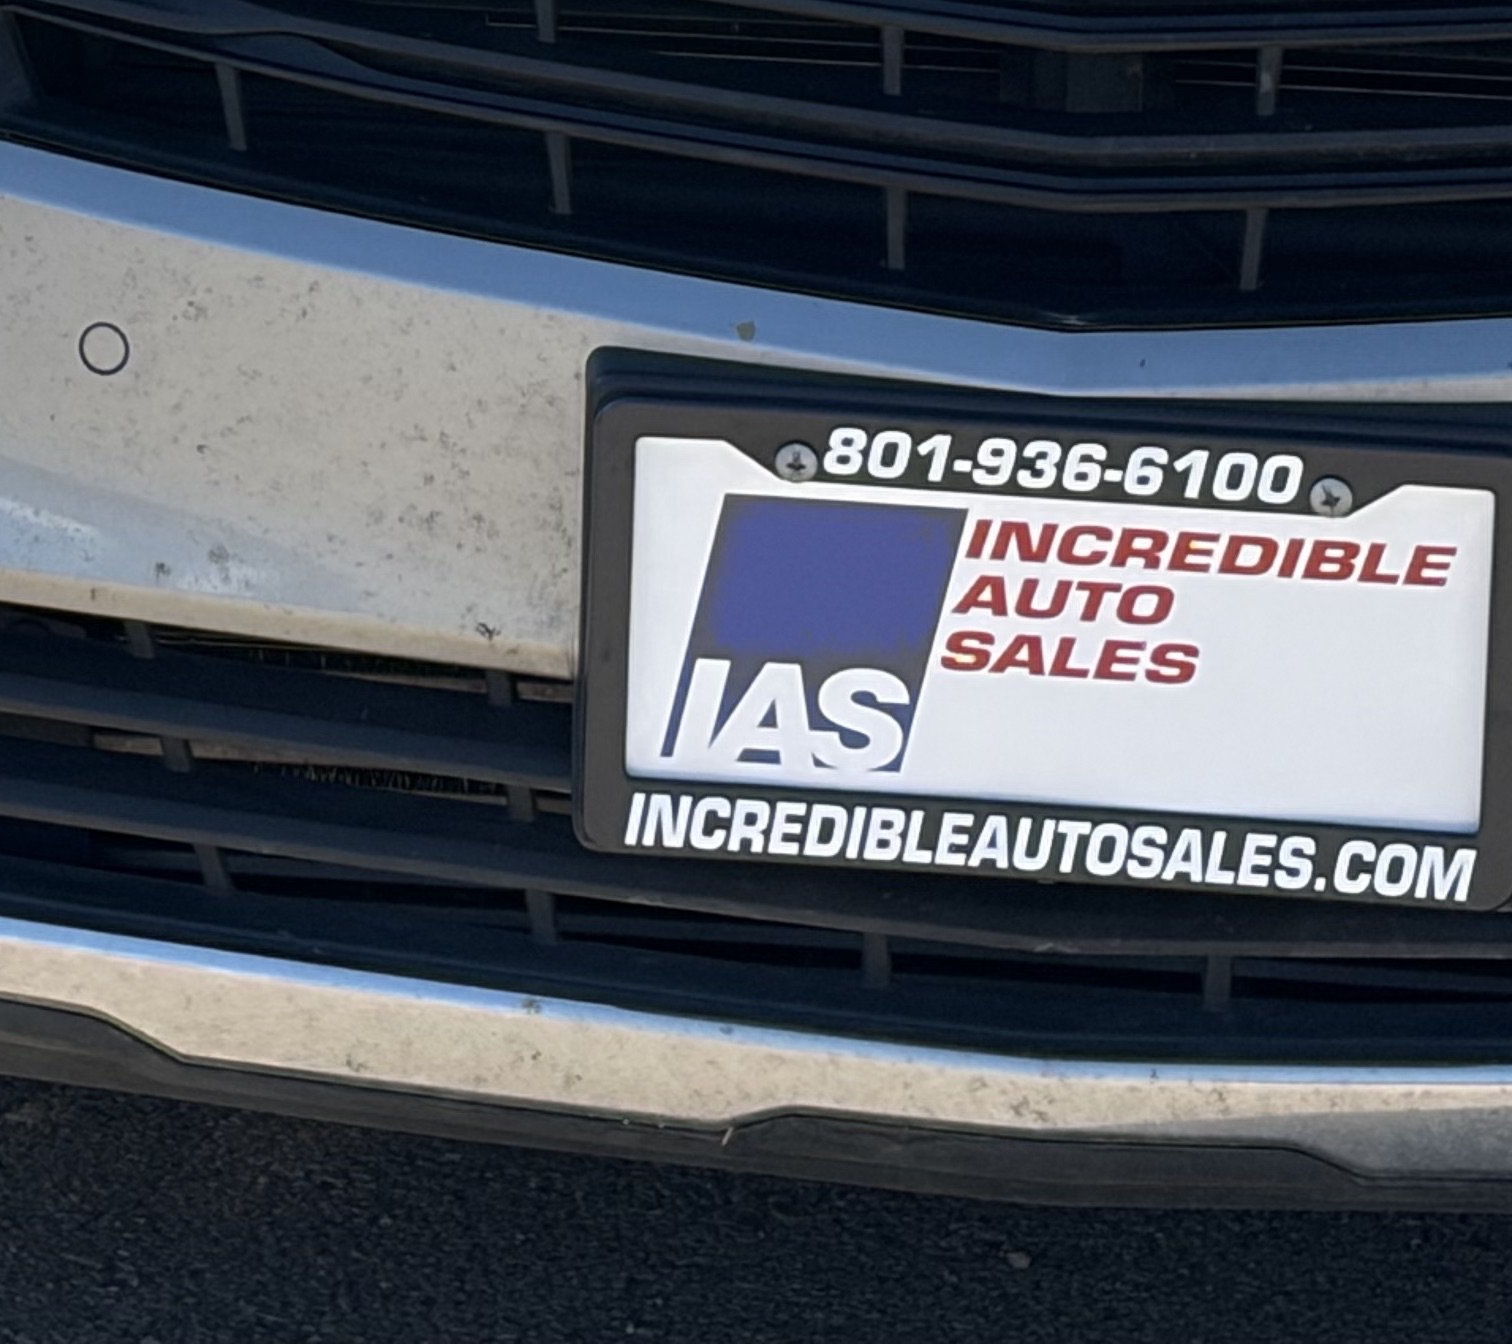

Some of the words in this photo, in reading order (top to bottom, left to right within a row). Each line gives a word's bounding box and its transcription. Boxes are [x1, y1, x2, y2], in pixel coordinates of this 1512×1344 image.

[822, 426, 1305, 505] 801-936-6100
[964, 518, 1458, 587] INCREDIBLE
[951, 574, 1176, 625] AUTO
[939, 630, 1200, 685] SALES
[670, 657, 911, 772] IAS
[623, 791, 1478, 902] INCREDIBLEAUTOSALES.COM
